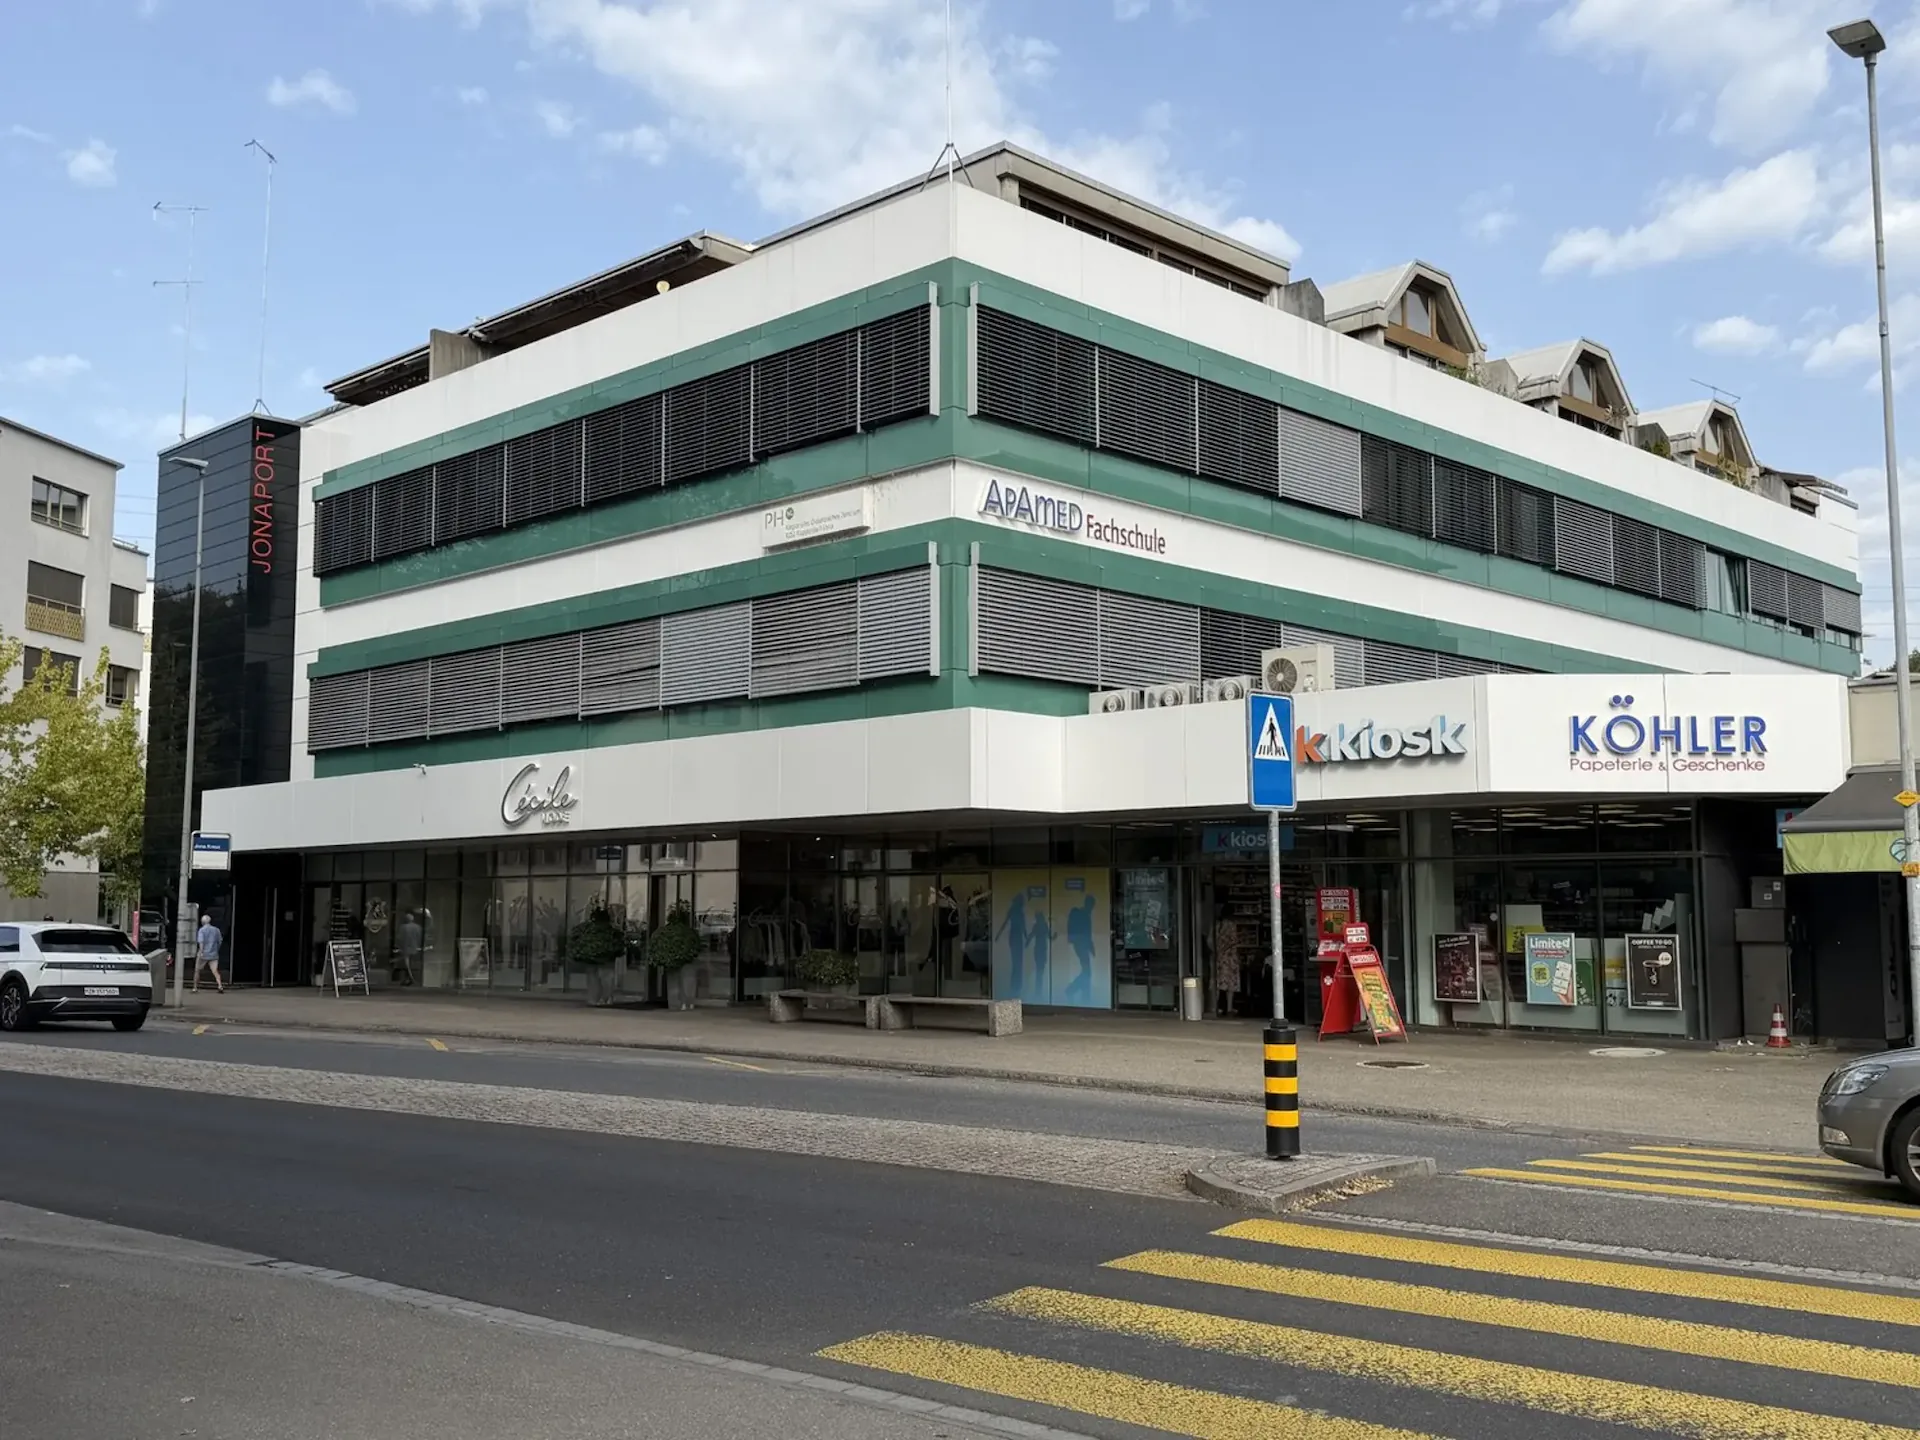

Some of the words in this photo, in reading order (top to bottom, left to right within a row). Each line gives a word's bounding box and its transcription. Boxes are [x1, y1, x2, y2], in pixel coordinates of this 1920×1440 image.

[252, 426, 275, 573] JONAPORT
[1086, 514, 1166, 554] Fachschule
[1329, 715, 1467, 762] kiosk
[1569, 694, 1768, 755] KÖHLER
[1570, 758, 1653, 773] Papeterie
[1658, 761, 1667, 772] &
[1672, 758, 1766, 772] Geschenke
[501, 763, 579, 826] Cécile
[1230, 830, 1271, 847] kios
[1530, 937, 1571, 949] Limited
